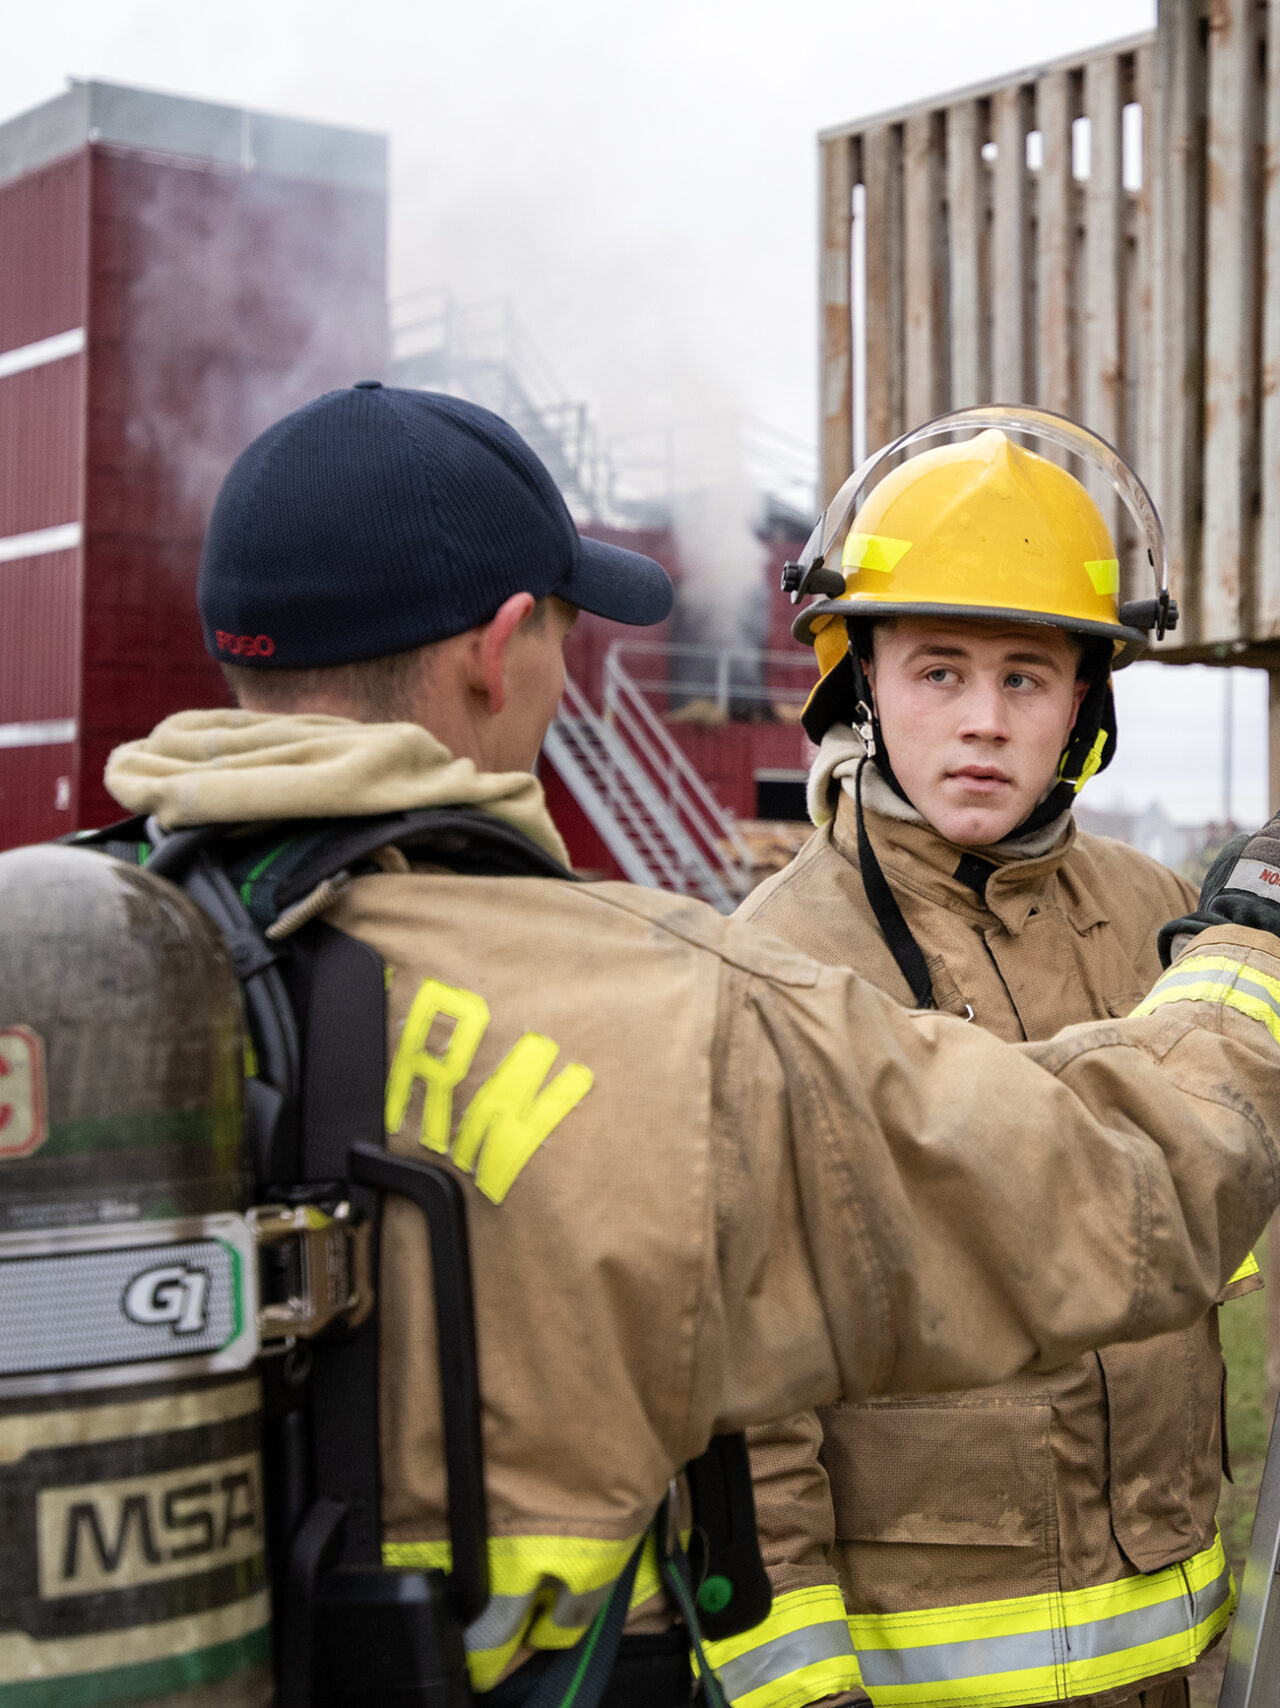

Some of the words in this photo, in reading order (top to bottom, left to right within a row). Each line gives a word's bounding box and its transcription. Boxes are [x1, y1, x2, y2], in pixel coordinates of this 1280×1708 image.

[383, 968, 594, 1206] RN
[123, 1262, 211, 1339] G1
[62, 1473, 255, 1581] MSA
